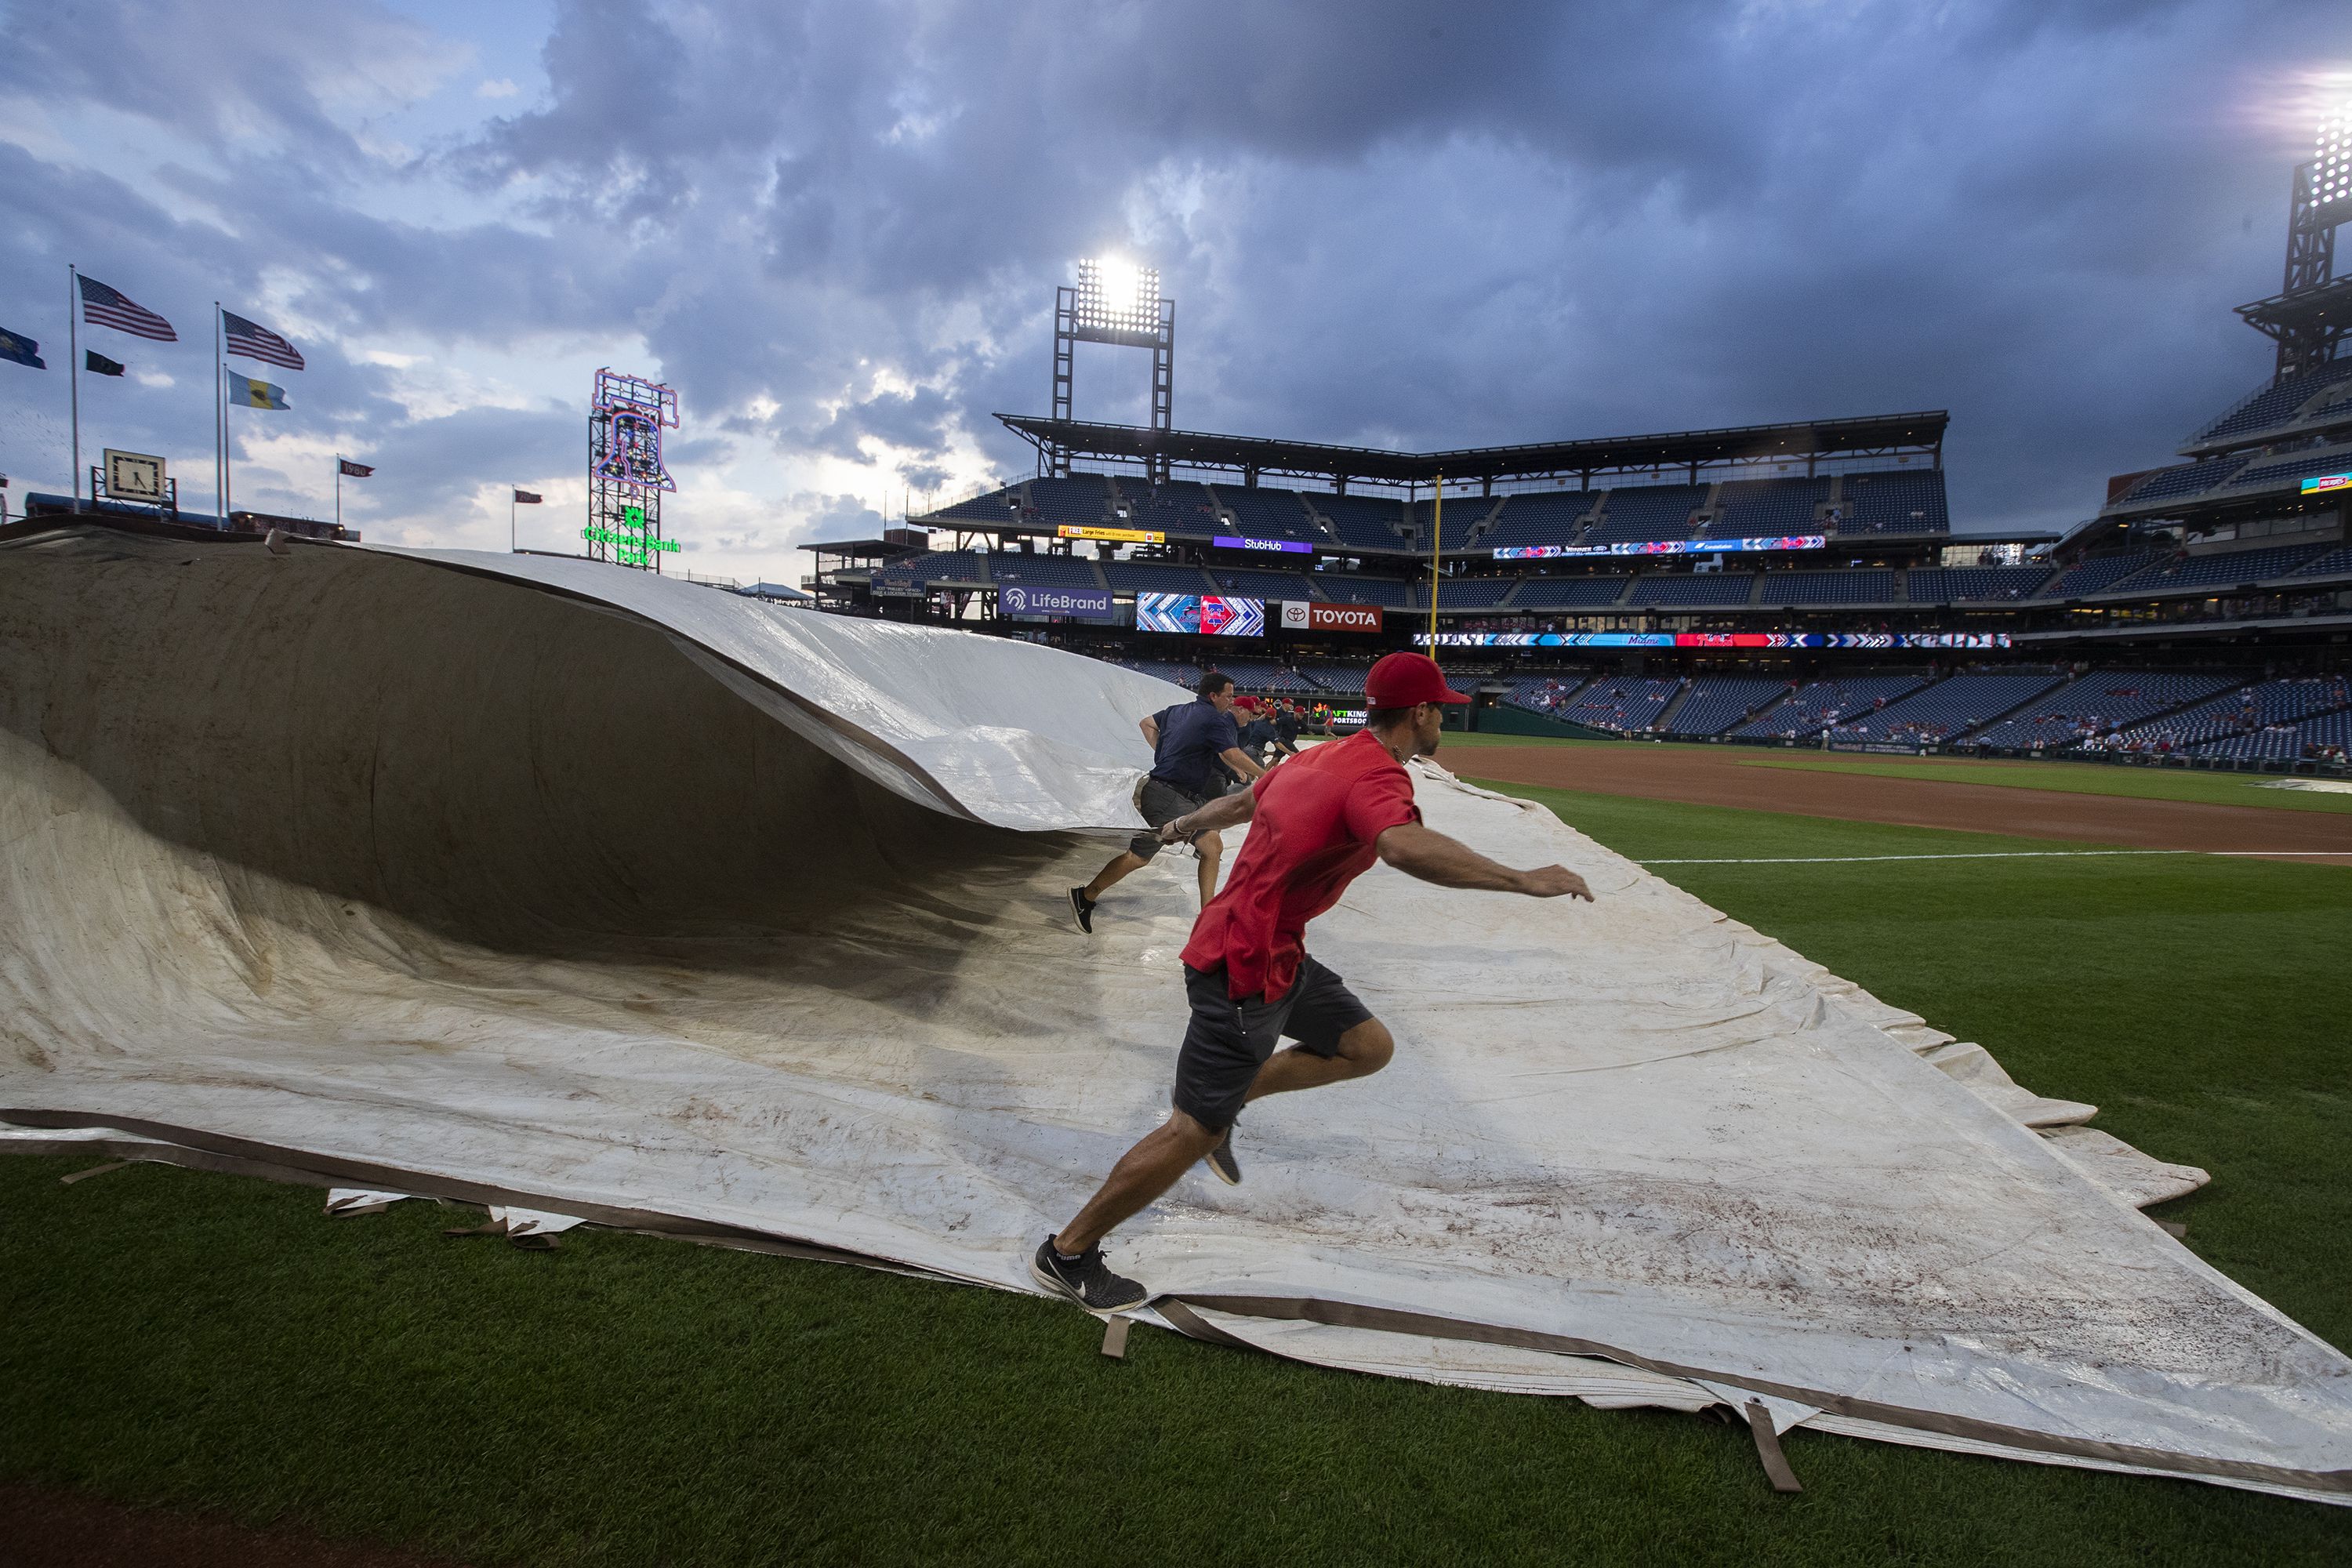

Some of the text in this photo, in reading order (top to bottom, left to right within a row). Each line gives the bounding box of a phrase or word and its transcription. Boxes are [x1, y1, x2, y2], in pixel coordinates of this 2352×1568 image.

[343, 463, 366, 477] 1980
[584, 526, 681, 553] Citizens Bank
[1244, 539, 1282, 550] StubHub
[618, 548, 648, 564] Park
[1032, 593, 1107, 610] LifeBrand
[1313, 610, 1377, 626] TOYOTA
